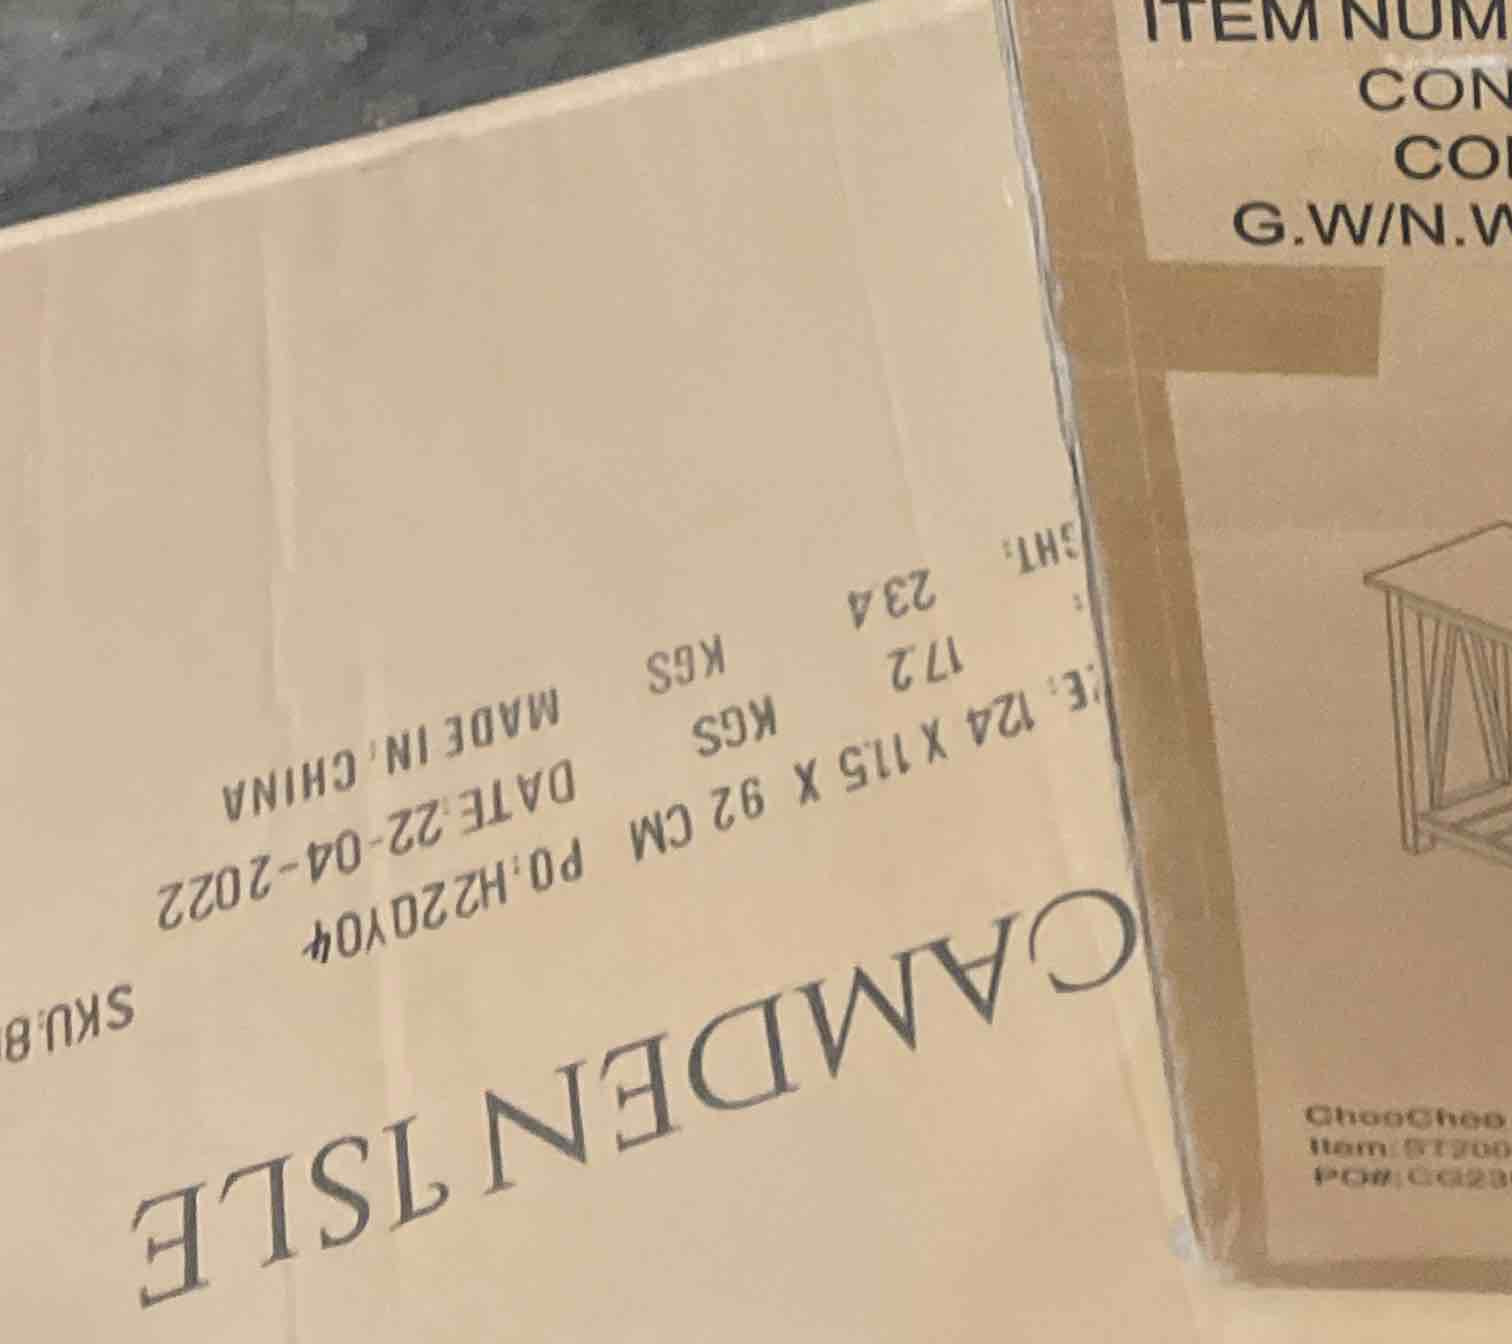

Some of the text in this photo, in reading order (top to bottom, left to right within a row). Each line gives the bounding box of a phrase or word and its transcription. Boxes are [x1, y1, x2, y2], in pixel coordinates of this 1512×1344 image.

[645, 632, 726, 696] KGS
[444, 686, 561, 759] MADE
[691, 693, 778, 759] KGS
[920, 716, 948, 764] X
[221, 747, 358, 823] CHINA
[709, 775, 766, 832] 92
[792, 756, 822, 808] X
[628, 802, 695, 864] CM
[2, 983, 135, 1064] SKU:8
[130, 887, 1139, 1309] CAMDEN ISLE
[1304, 1104, 1507, 1131] ChooChoo
